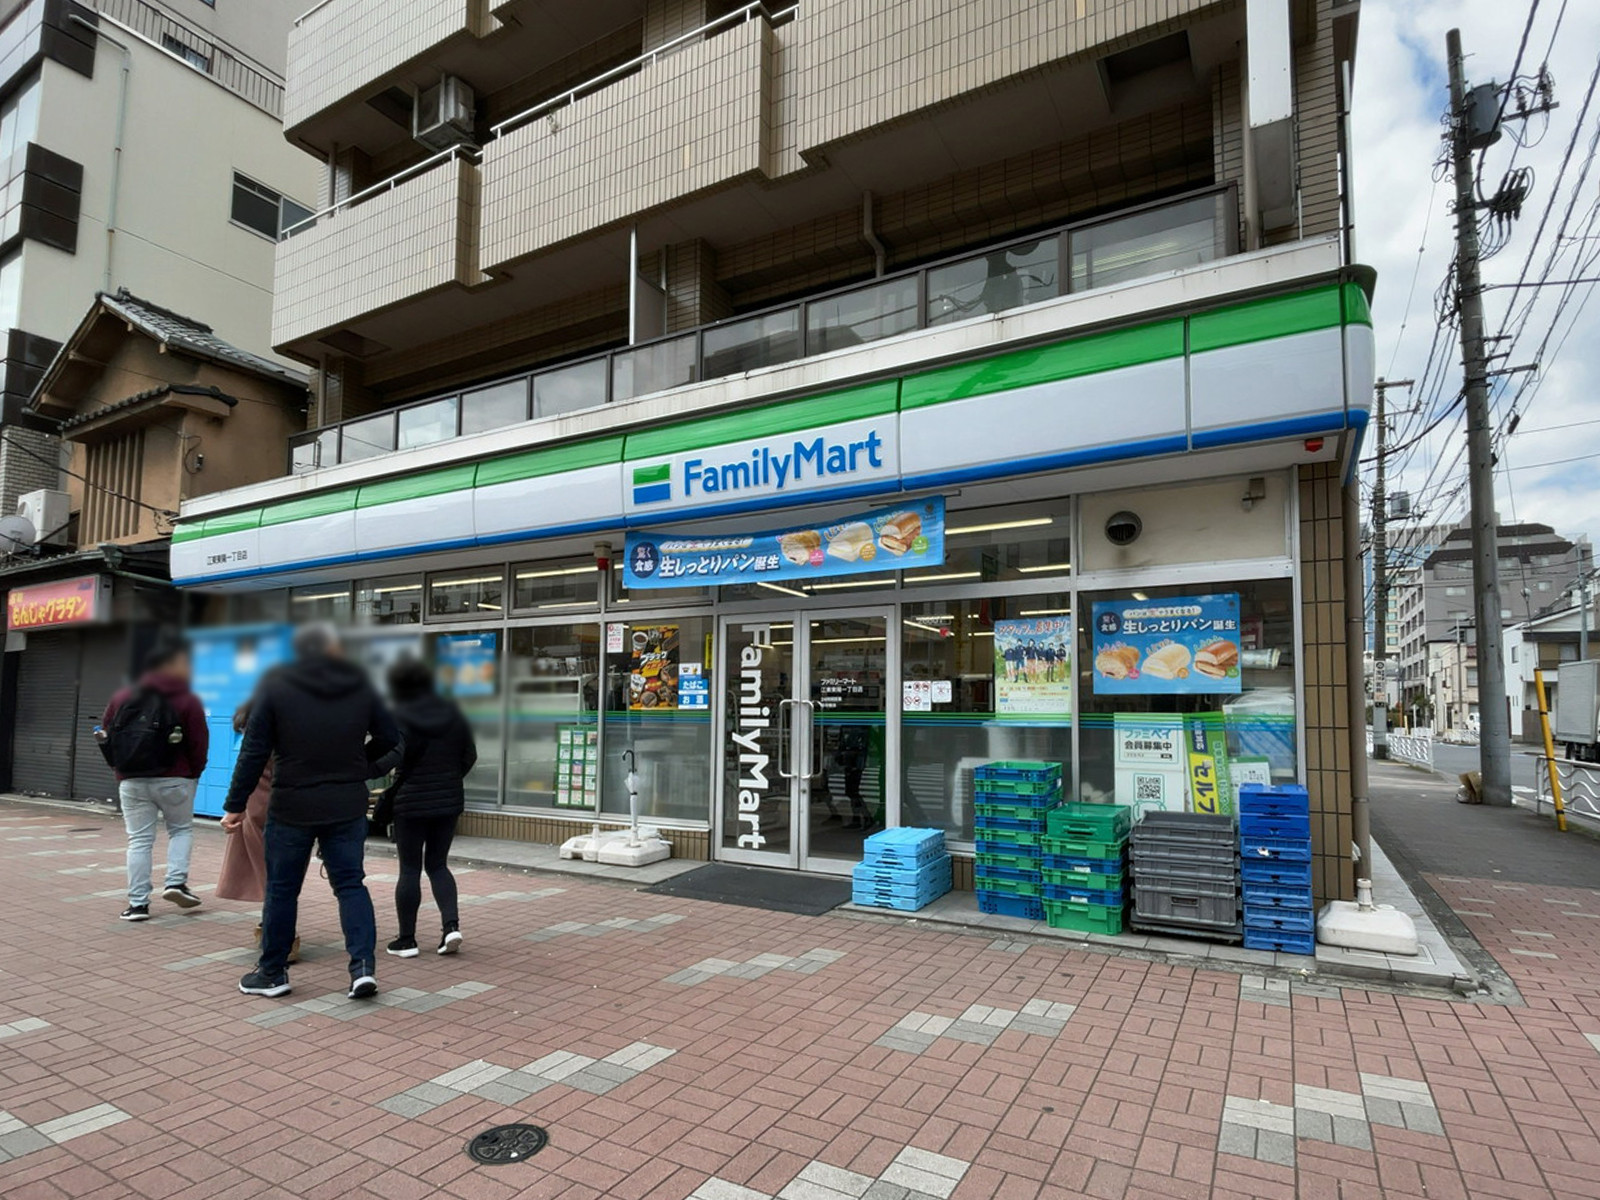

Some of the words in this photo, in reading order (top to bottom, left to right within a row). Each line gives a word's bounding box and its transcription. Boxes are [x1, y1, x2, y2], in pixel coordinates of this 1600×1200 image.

[684, 430, 882, 497] FamilyMart
[634, 560, 654, 572] 食感
[658, 553, 780, 578] 生しっとりパン誕生
[12, 595, 87, 626] もんじゃグラタン
[1122, 619, 1237, 635] 生しっとりパン誕生
[682, 680, 703, 690] たばこ
[820, 678, 857, 686] ファミリーマート
[732, 623, 771, 850] FamilyMart
[1124, 741, 1172, 751] 会員募集中
